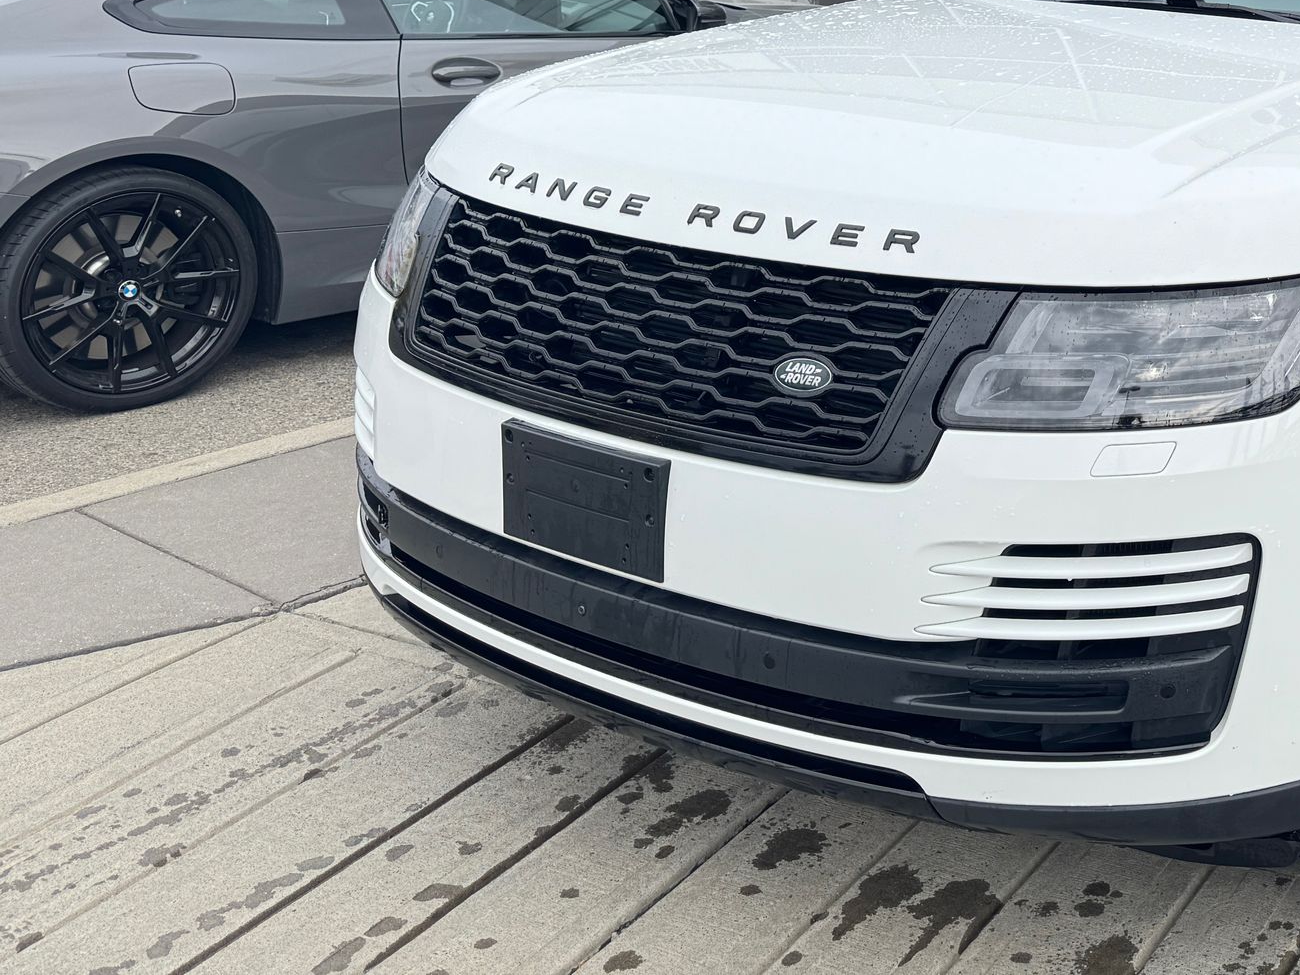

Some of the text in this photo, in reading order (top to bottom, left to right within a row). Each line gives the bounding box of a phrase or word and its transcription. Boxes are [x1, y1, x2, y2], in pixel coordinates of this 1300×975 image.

[488, 162, 920, 254] RANGE ROVER
[785, 361, 816, 374] LAND
[785, 372, 821, 387] ROVER
